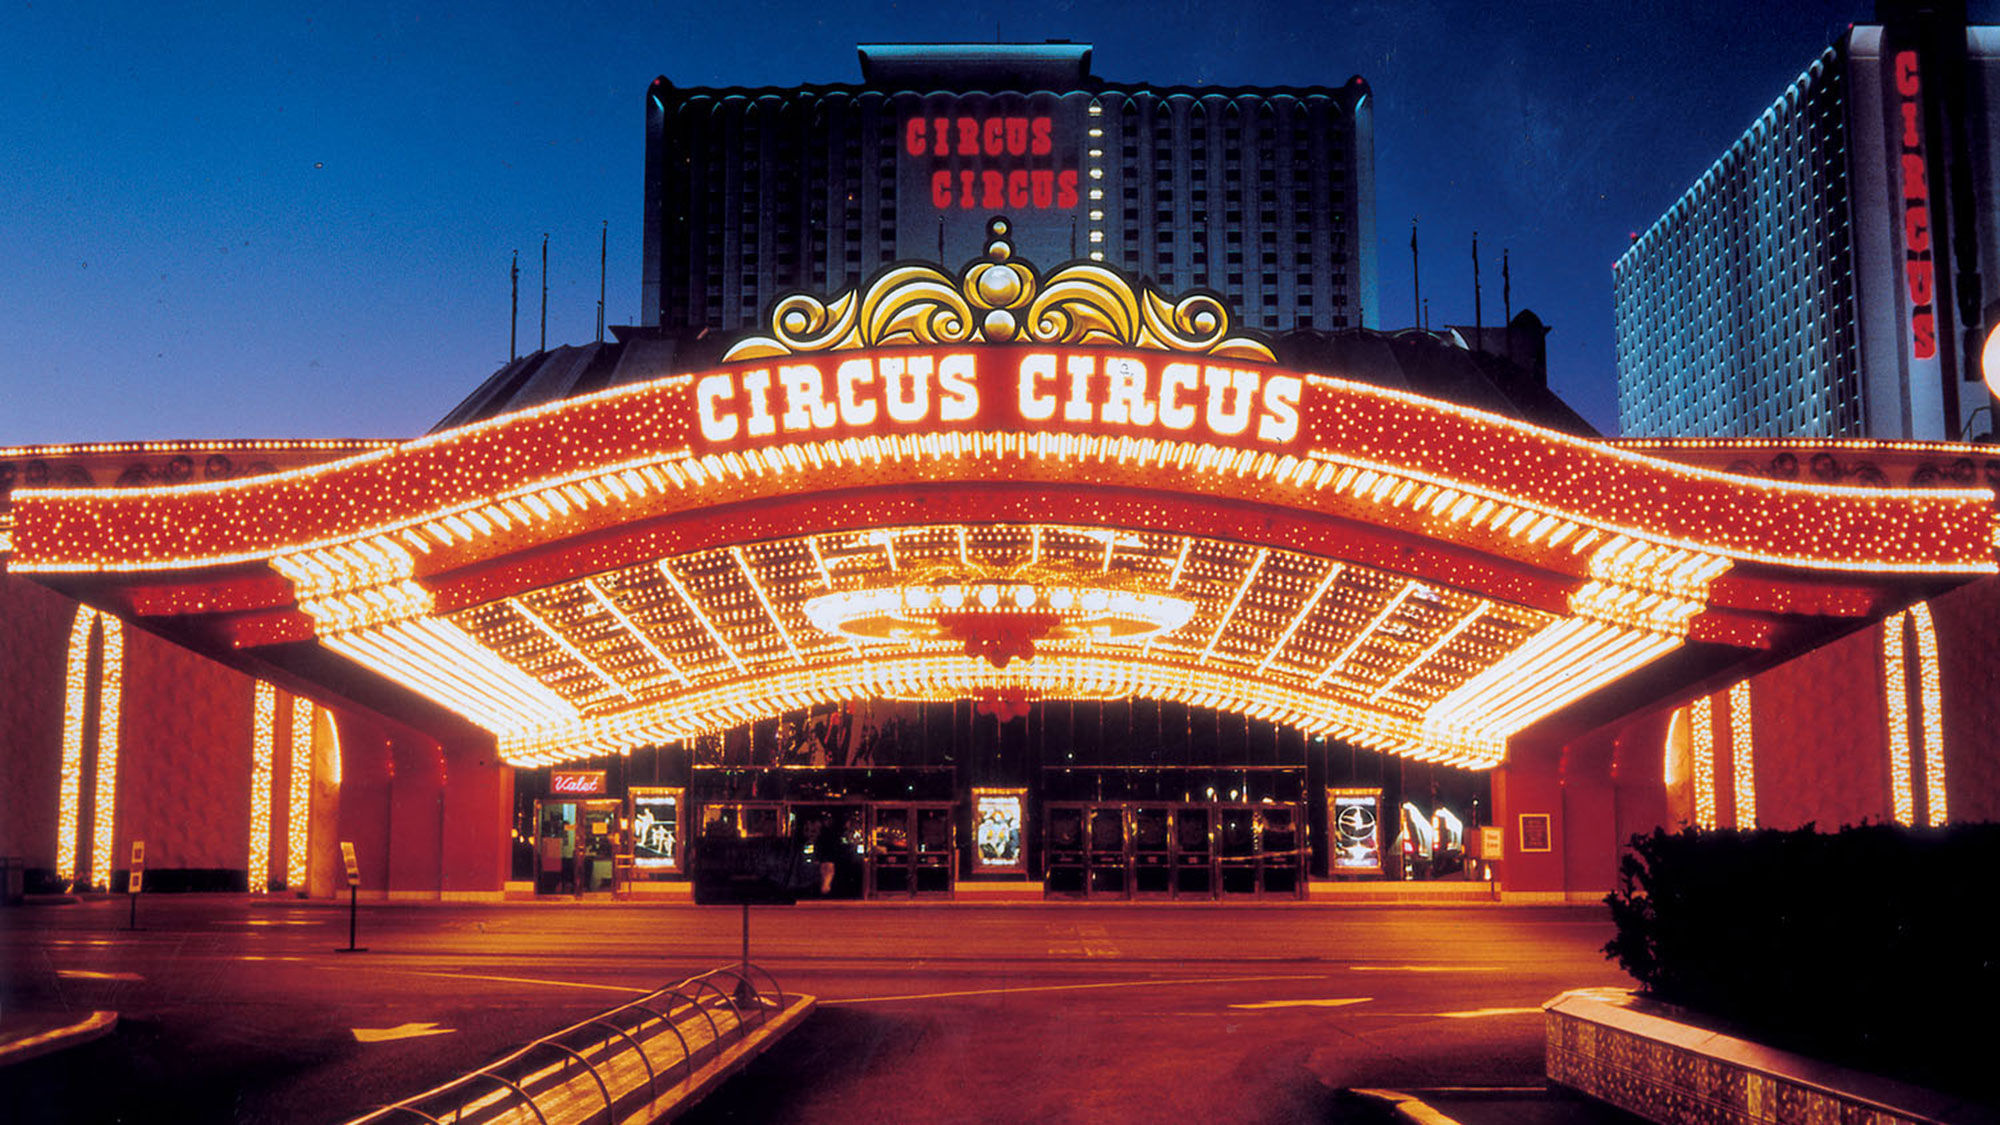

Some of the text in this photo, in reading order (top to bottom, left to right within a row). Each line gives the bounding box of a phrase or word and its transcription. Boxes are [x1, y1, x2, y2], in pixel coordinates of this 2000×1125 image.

[906, 117, 1052, 156] CIRCUS
[932, 170, 1078, 209] CIRCUS
[1896, 51, 1936, 359] CIRCUS
[697, 353, 1302, 443] CIRCUS CIRCUS
[555, 776, 599, 791] Valet
